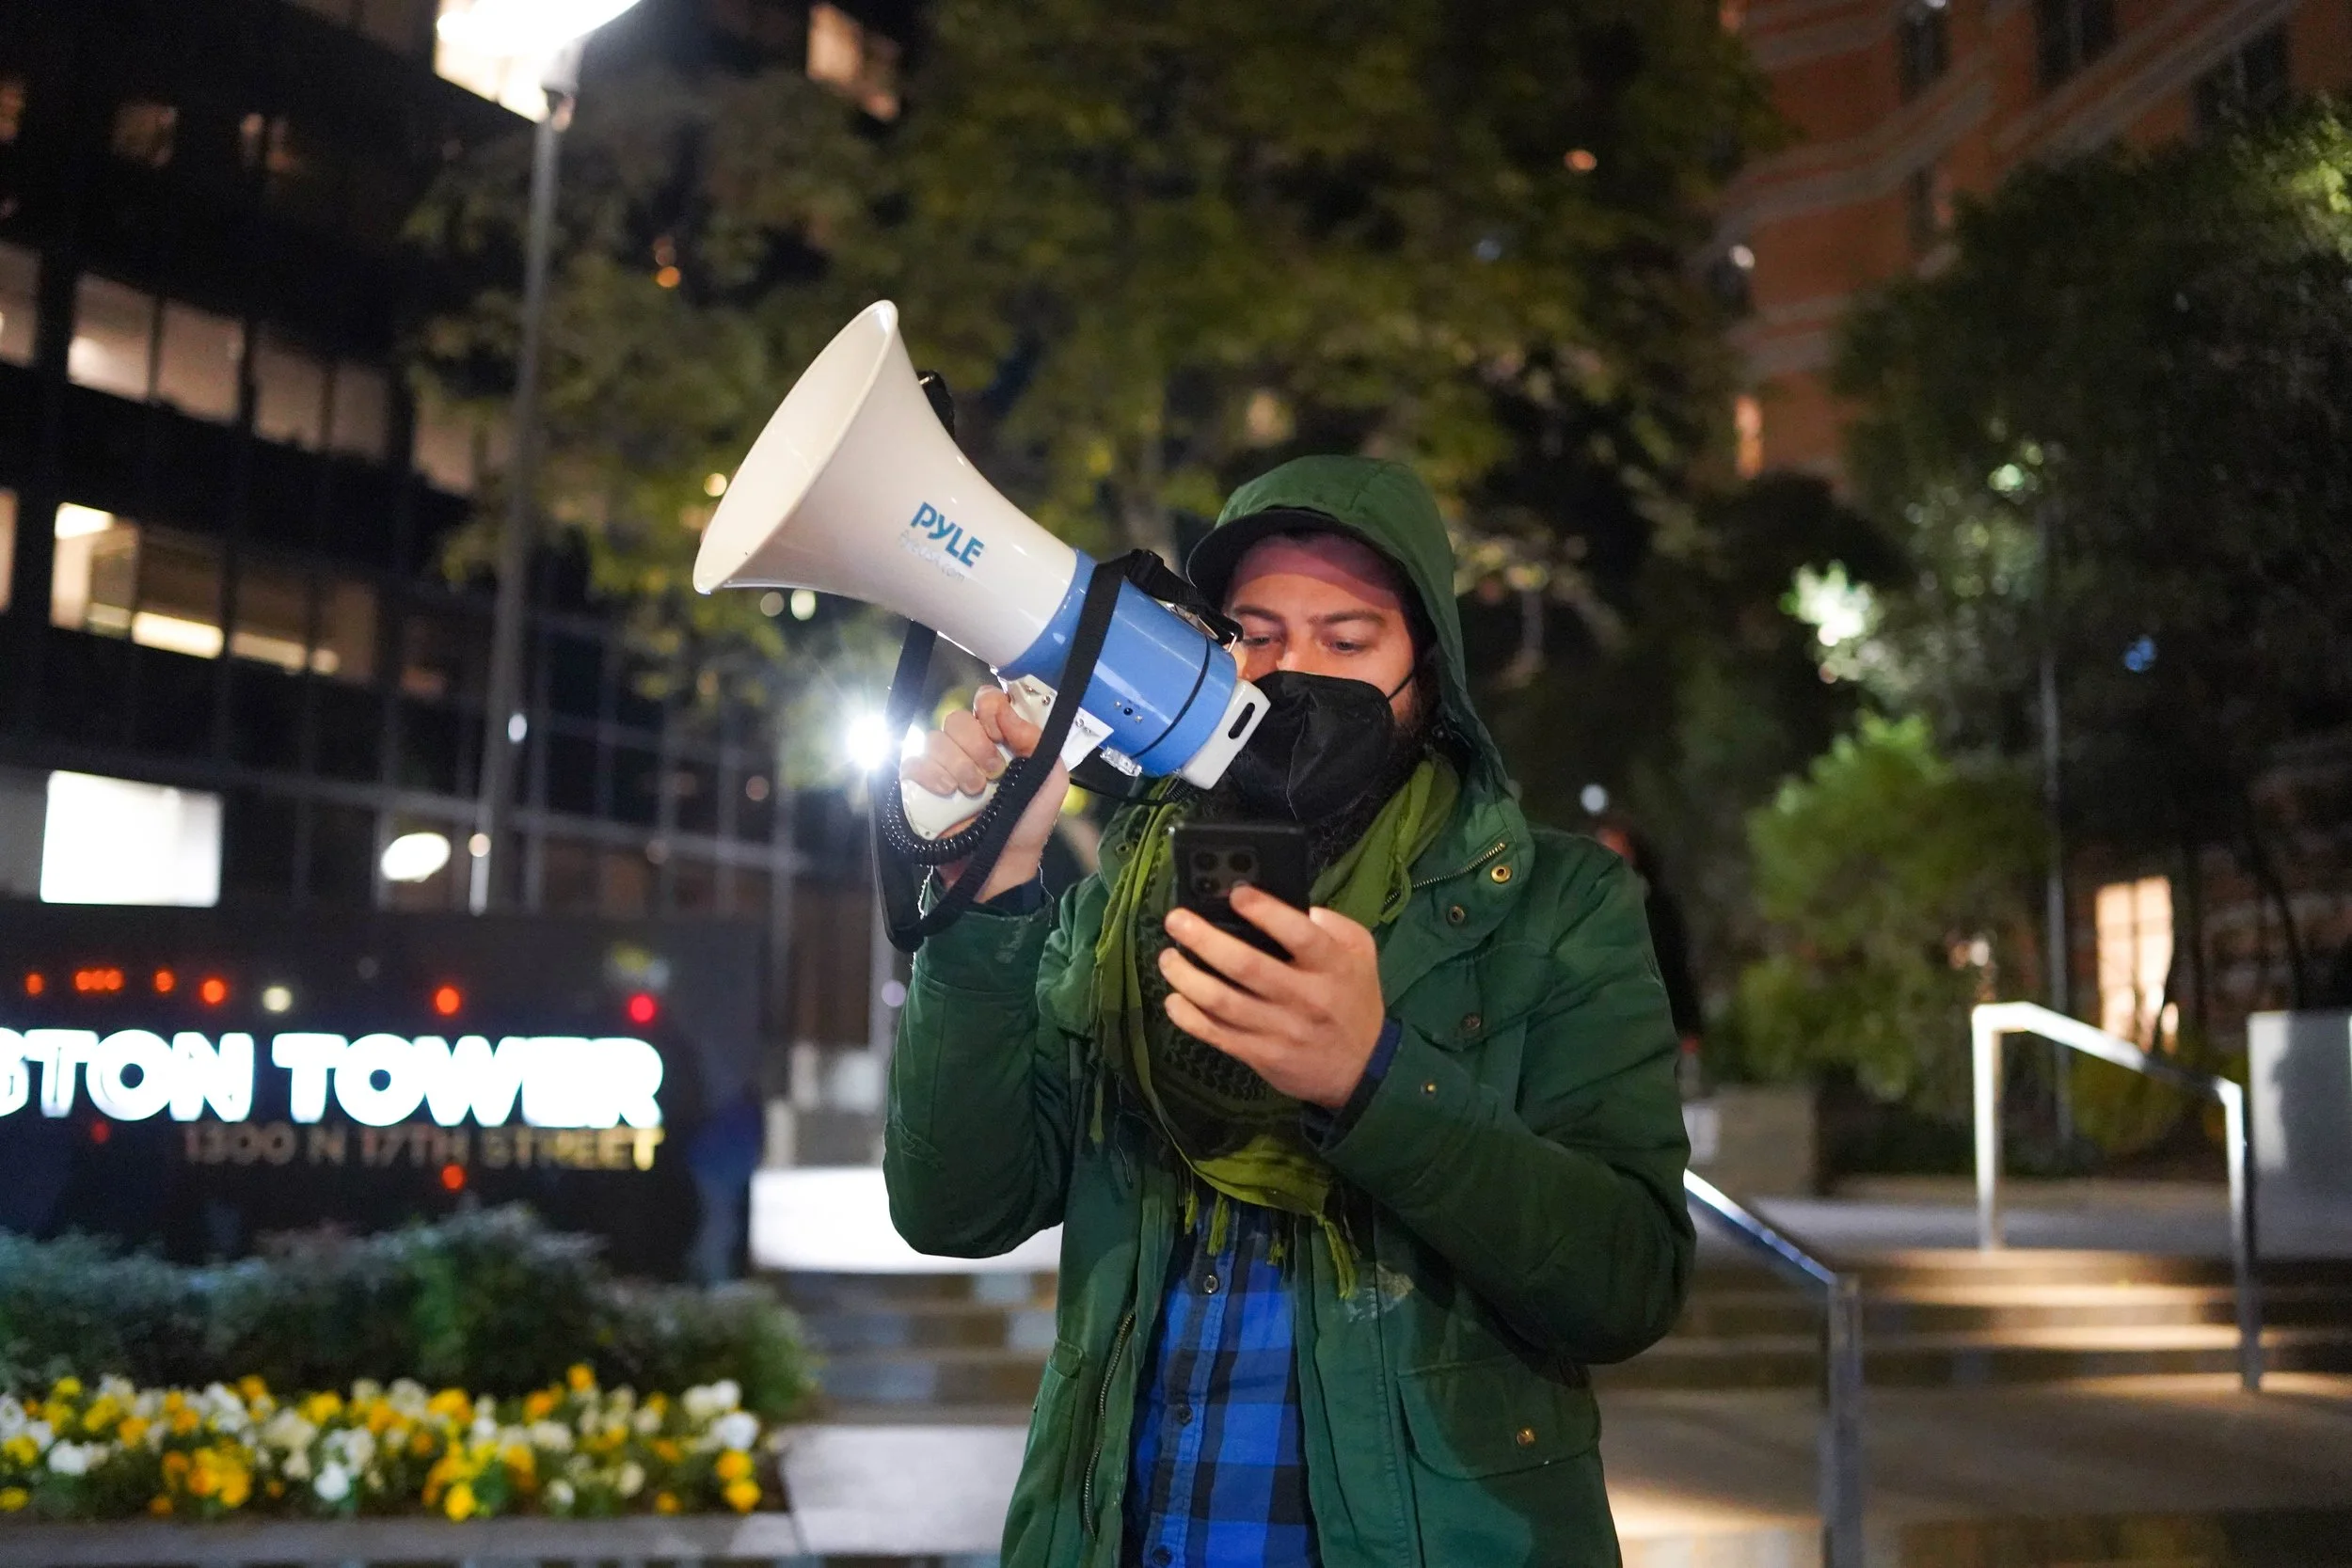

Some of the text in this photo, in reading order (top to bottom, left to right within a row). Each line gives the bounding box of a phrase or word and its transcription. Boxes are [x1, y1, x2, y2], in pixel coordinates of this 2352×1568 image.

[911, 501, 984, 567] PYLE
[272, 1033, 663, 1129] TOWER
[185, 1122, 664, 1170] 1300 N 17TH STREET
